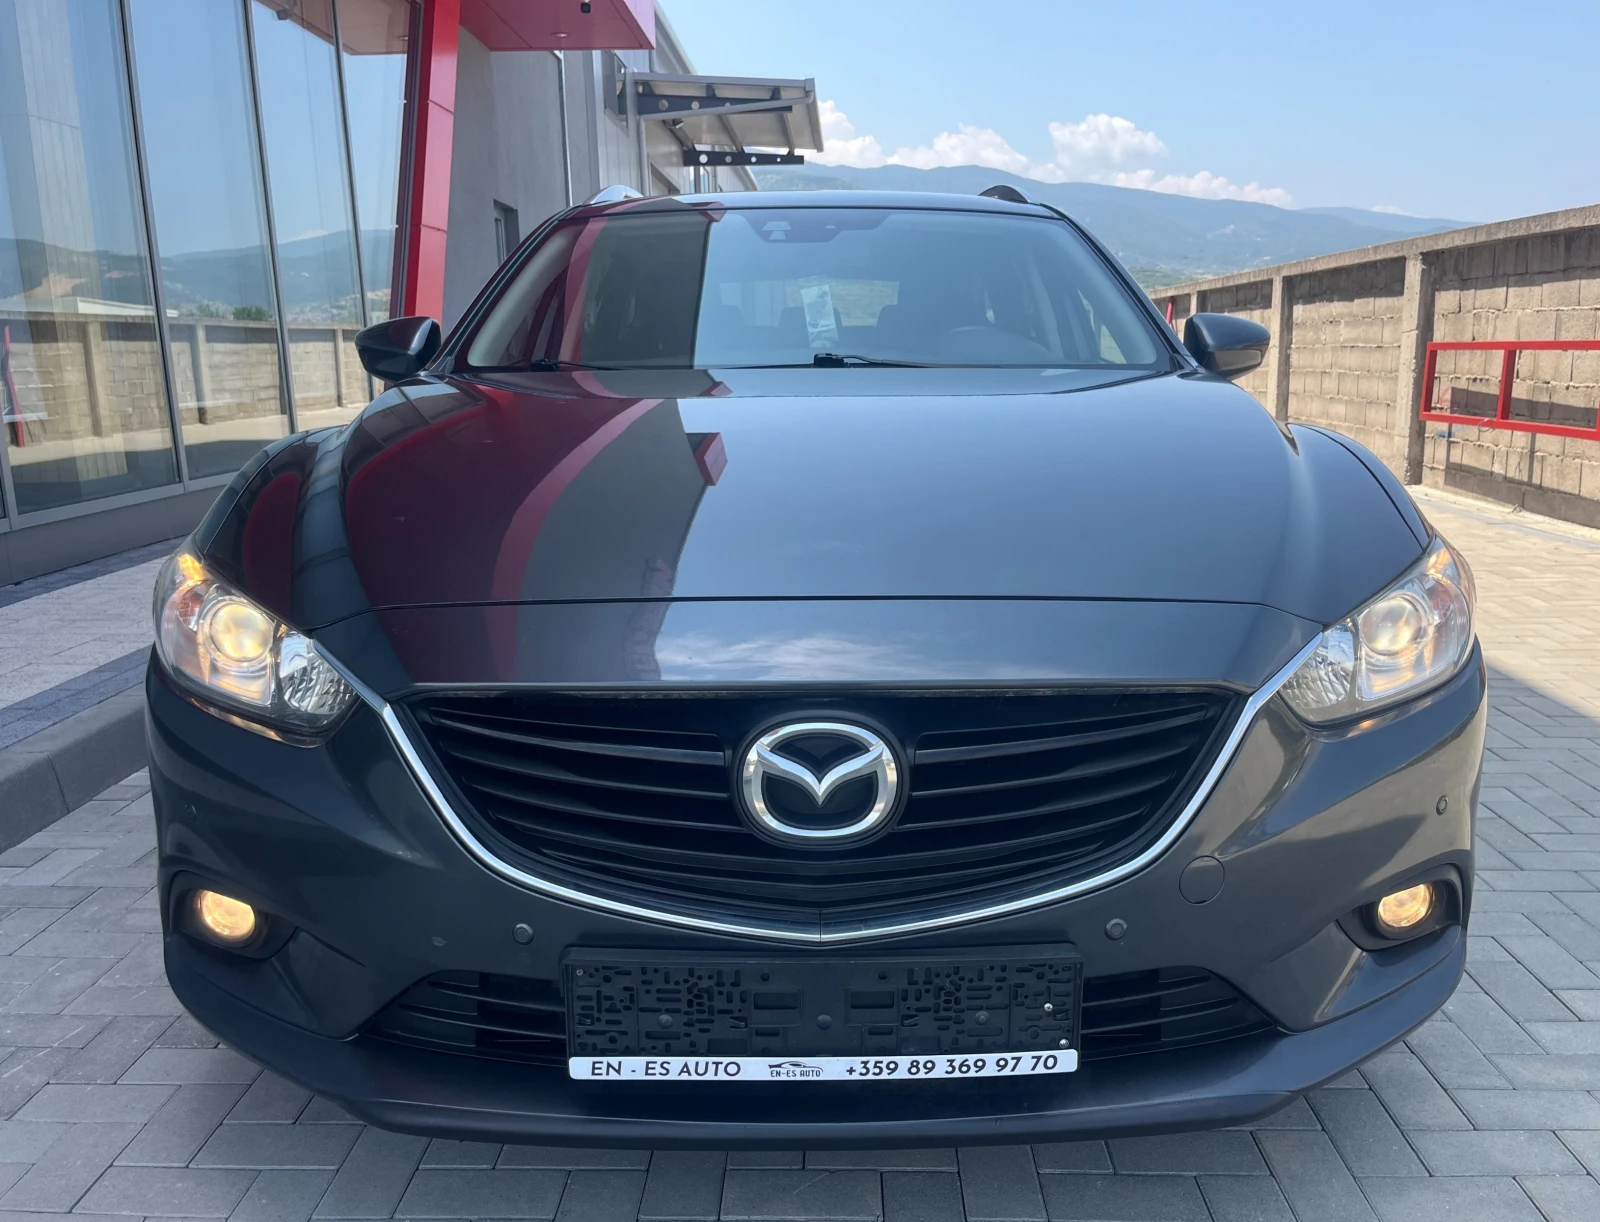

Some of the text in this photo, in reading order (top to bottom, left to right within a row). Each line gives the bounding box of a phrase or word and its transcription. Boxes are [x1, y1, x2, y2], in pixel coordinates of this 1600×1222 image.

[591, 1061, 622, 1076] EN
[644, 1061, 671, 1077] ES
[677, 1061, 741, 1077] AUTO
[770, 1069, 821, 1078] EN-ES AUTO
[846, 1054, 1058, 1077] +359 89 369 97 70
